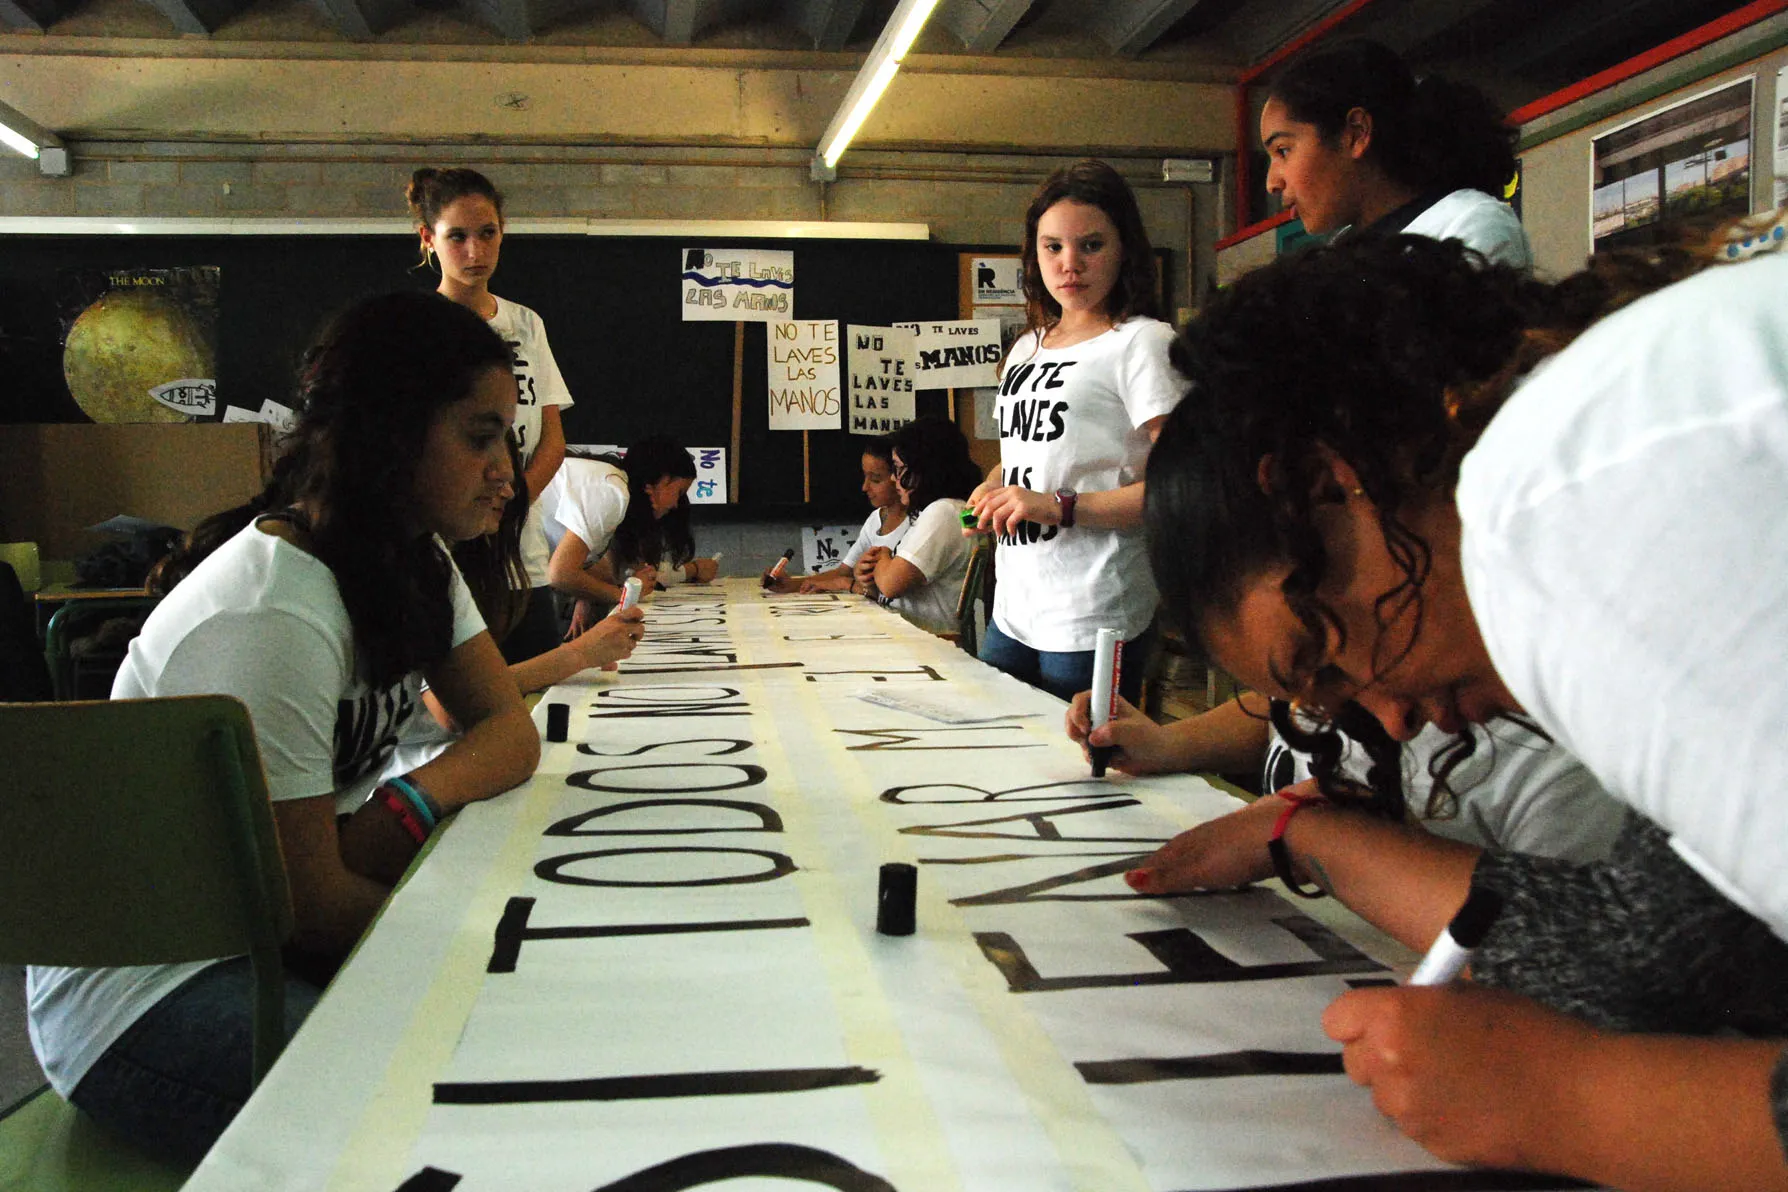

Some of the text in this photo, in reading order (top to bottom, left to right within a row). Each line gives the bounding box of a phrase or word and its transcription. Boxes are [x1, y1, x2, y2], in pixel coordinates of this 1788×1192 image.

[109, 276, 165, 286] THE MOON
[715, 261, 741, 283] TE
[776, 323, 836, 341] NO TE
[856, 334, 884, 351] NO
[774, 346, 836, 364] LAVES
[920, 344, 1000, 370] MANOS
[788, 366, 816, 380] LAS
[880, 358, 905, 376] TE
[853, 374, 913, 392] LAVES
[1031, 361, 1078, 392] TE
[770, 386, 839, 416] MANOS
[855, 395, 889, 409] LAS
[852, 416, 911, 431] MANO
[1000, 399, 1069, 442] LAVES
[589, 686, 753, 718] NO
[486, 737, 811, 973] TODOS
